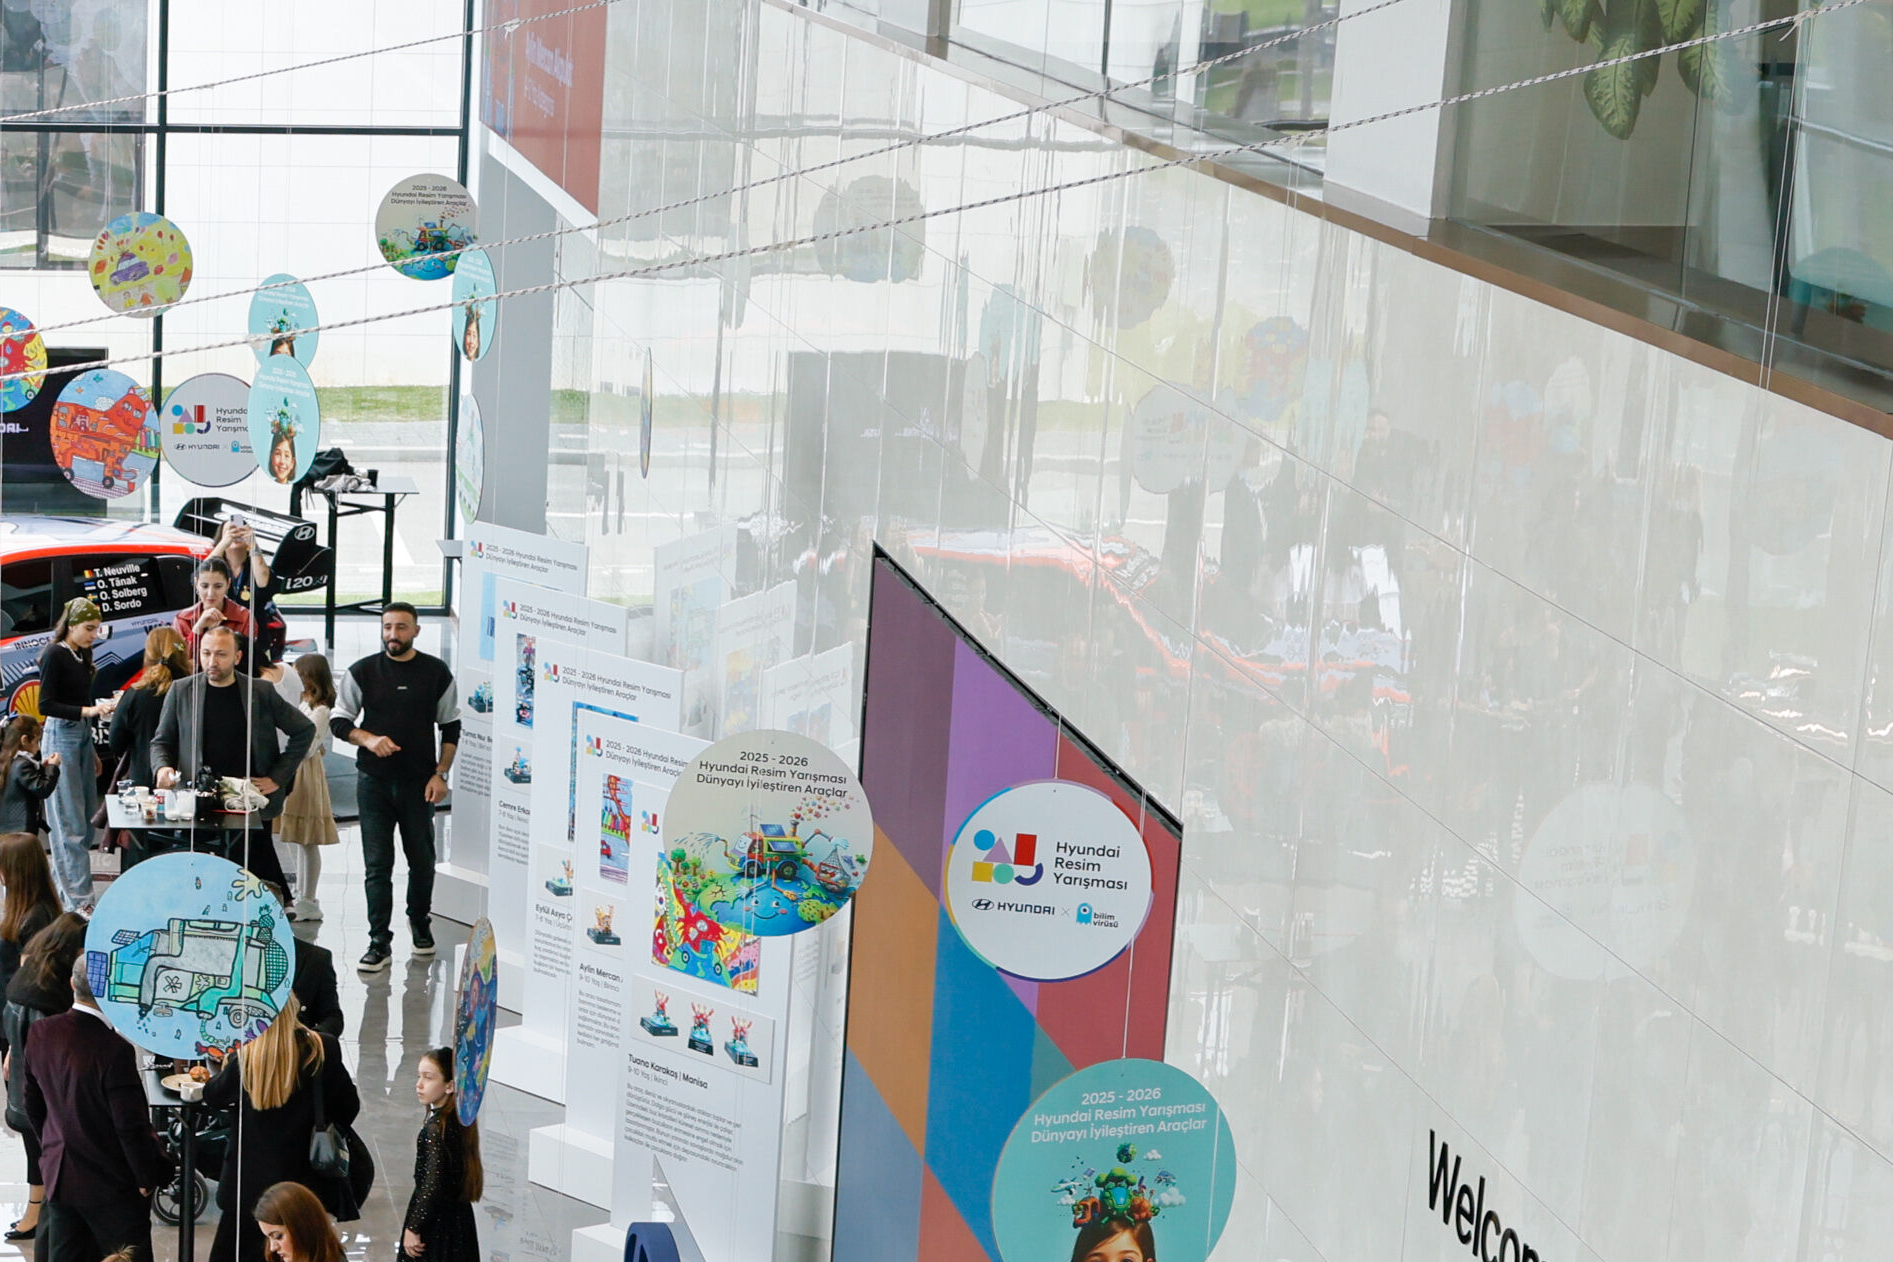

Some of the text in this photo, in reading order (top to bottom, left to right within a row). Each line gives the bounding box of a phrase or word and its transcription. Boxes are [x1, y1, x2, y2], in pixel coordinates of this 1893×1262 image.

[94, 564, 140, 577] T. Neuville
[97, 576, 137, 588] O. Tänak
[100, 587, 147, 600] O. Solberg
[102, 600, 141, 612] D. Sordo
[562, 667, 576, 676] 2025
[582, 672, 596, 681] 2026
[597, 676, 621, 687] Hyundai
[623, 681, 641, 692] Resim
[562, 676, 585, 689] Dünyayı
[615, 689, 637, 701] Araçlar
[606, 739, 621, 750] 2025
[626, 745, 642, 756] 2026
[643, 751, 669, 762] Hyundai
[740, 752, 808, 766] 2025 2026
[606, 751, 629, 764] Dünyayı
[632, 757, 661, 772] İyileştiren
[700, 761, 847, 784] Hyundai Resim Yarışması
[697, 773, 848, 798] Dünyayı İyileştiren Araçlar
[1056, 842, 1120, 858] Hyundai
[1055, 857, 1100, 872] Resim
[1054, 872, 1127, 890] Yarışması
[997, 902, 1115, 920] HYUNDAI bilim
[651, 1062, 678, 1080] Karakaş
[683, 1073, 708, 1088] Manisa
[1082, 1088, 1161, 1105] 2025 2026
[1034, 1102, 1205, 1127] Hyundai Resim Yarışması
[1031, 1118, 1207, 1143] Dünyayı İyileştiren Araçlar
